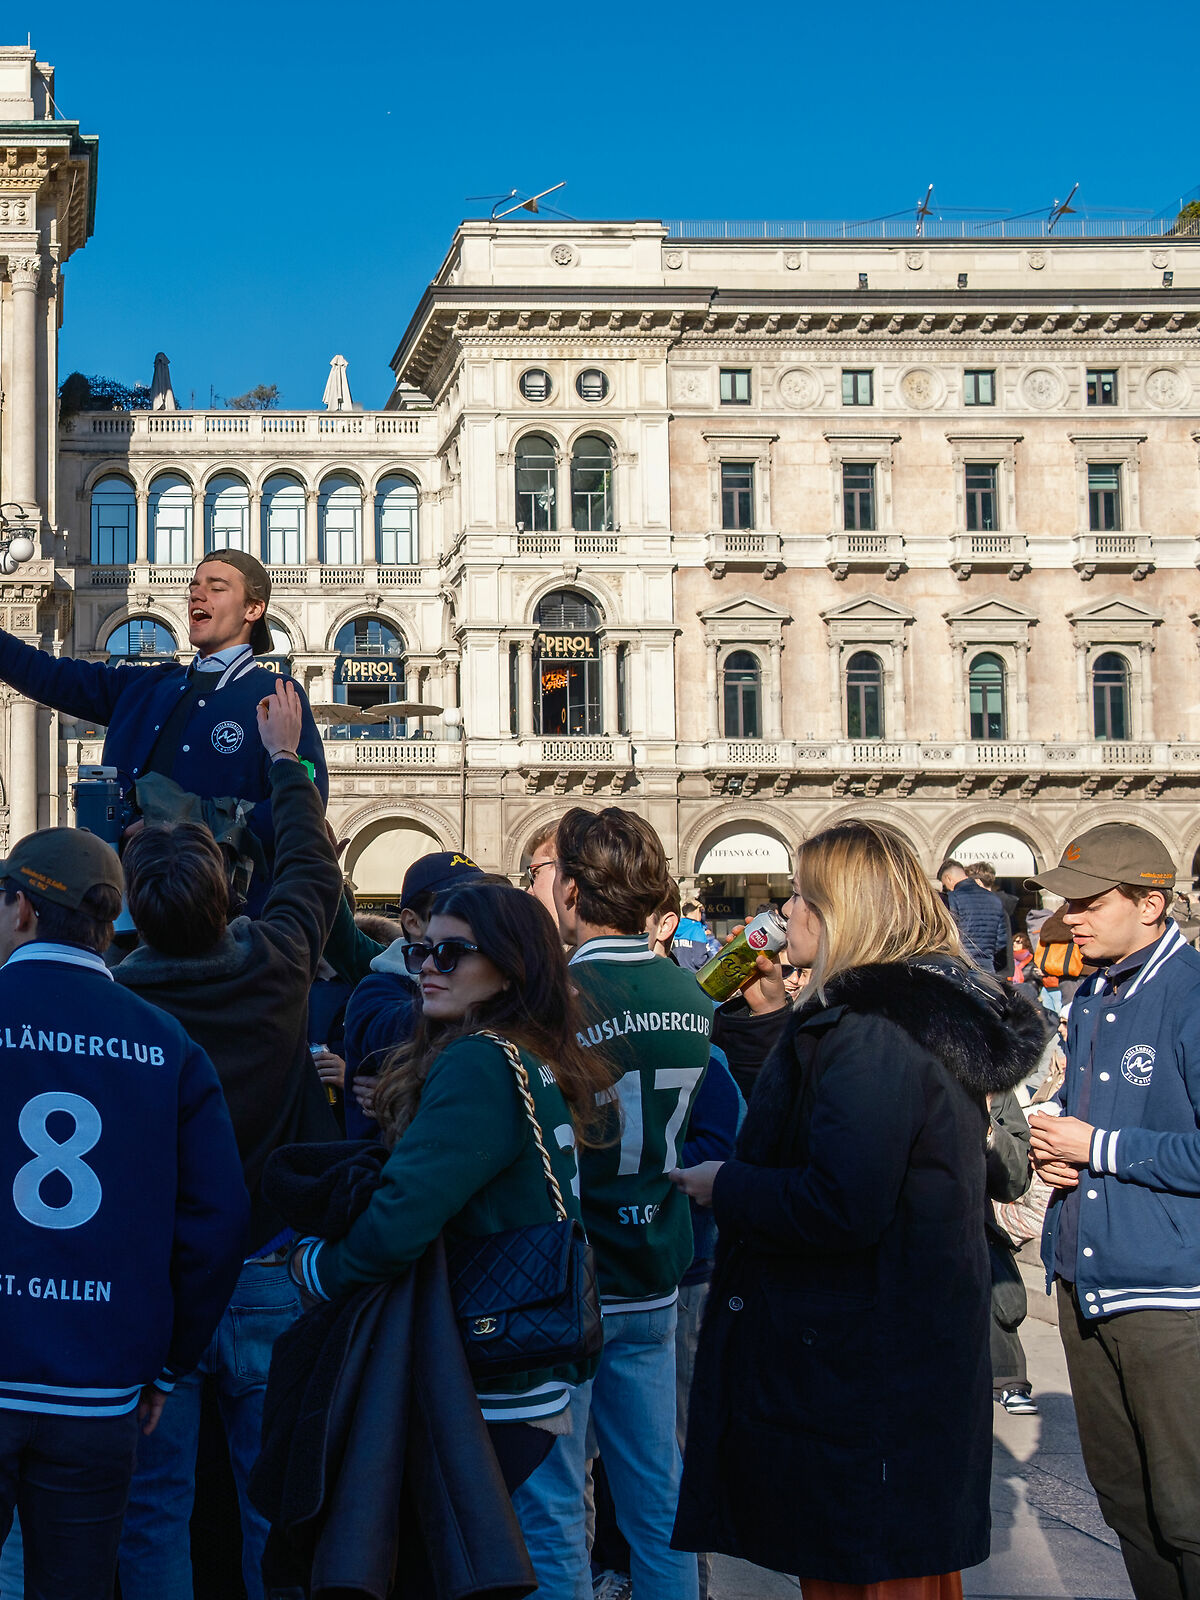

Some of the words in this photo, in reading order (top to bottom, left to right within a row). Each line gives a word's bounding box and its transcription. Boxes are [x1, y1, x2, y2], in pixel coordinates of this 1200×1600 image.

[533, 634, 594, 652] APEROL
[341, 658, 397, 677] APEROL
[709, 848, 745, 857] TIFFANY
[746, 849, 753, 857] &
[954, 851, 991, 860] TIFFANY
[992, 851, 998, 860] &
[707, 904, 715, 913] &
[575, 1010, 710, 1048] AUSLÄNDERCLUB
[594, 1066, 705, 1176] 17
[12, 1091, 102, 1230] 8
[28, 1277, 111, 1302] GALLEN
